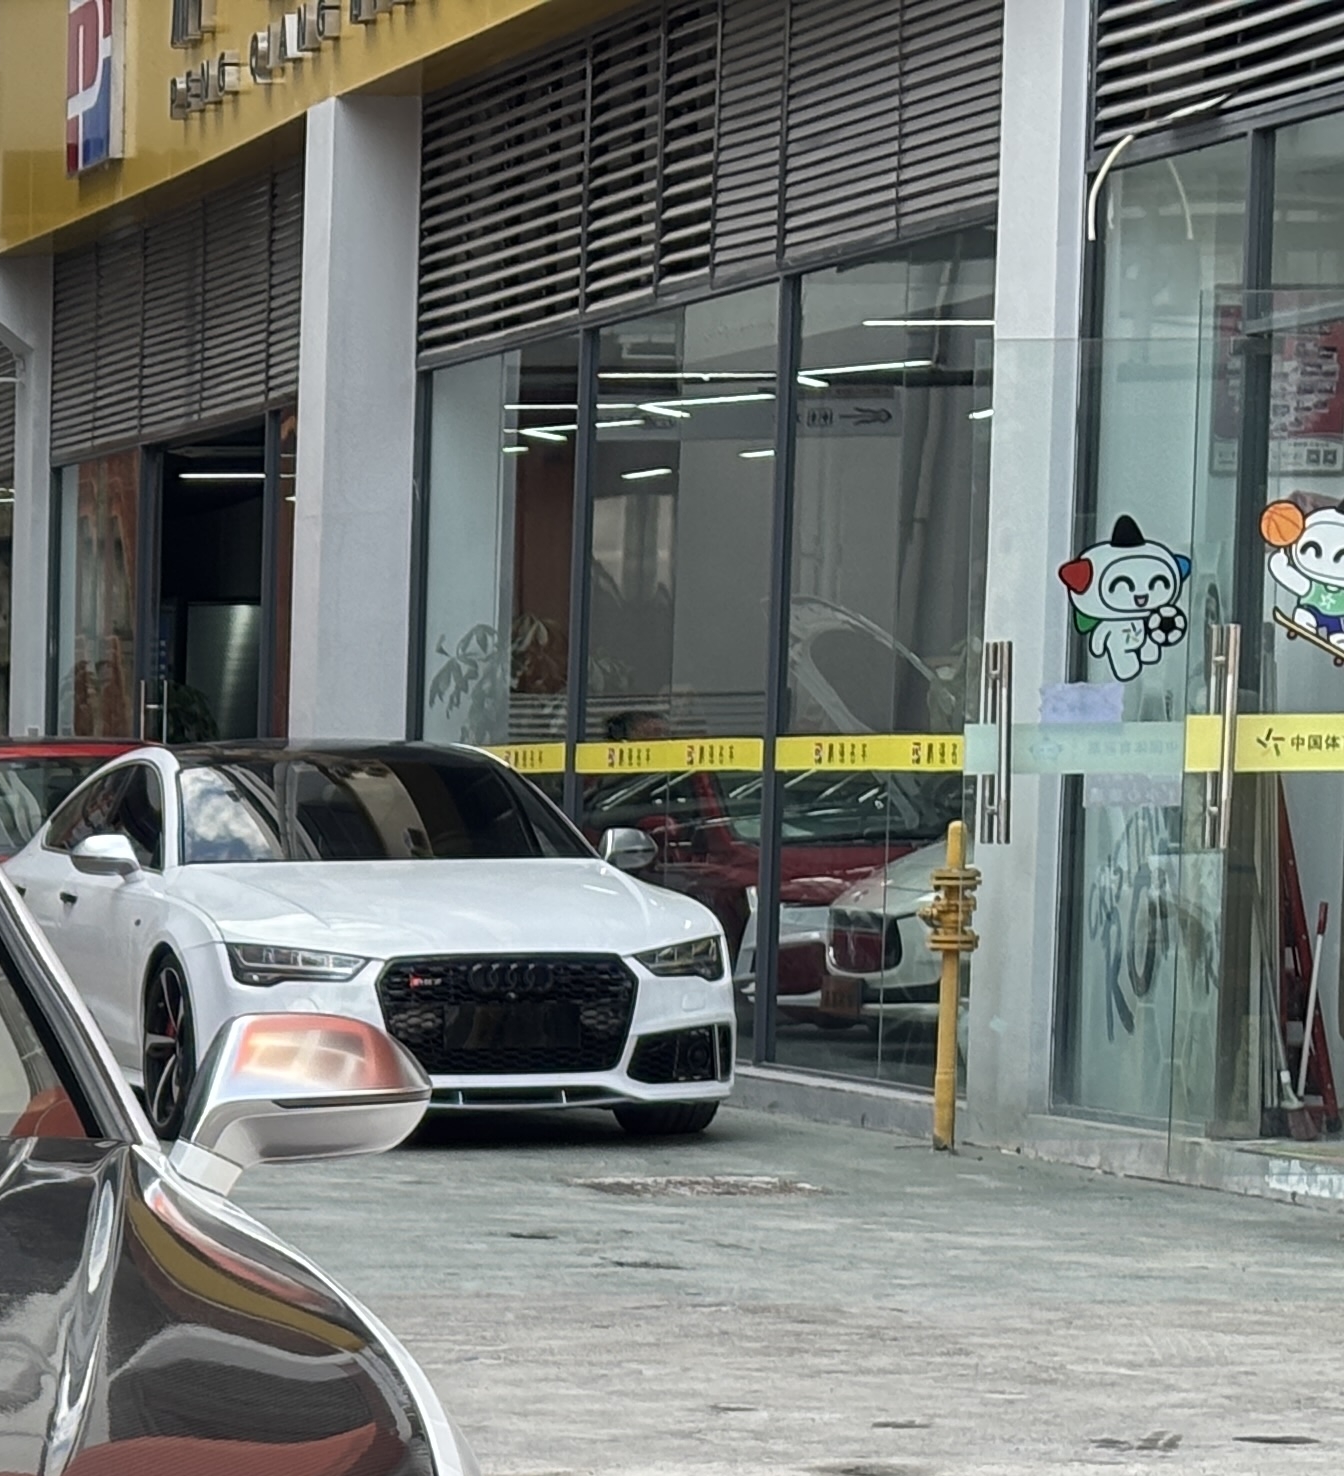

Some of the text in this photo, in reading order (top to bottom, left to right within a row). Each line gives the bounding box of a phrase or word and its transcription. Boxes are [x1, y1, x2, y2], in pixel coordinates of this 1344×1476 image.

[170, 51, 240, 120] PENG
[249, 0, 340, 83] QIANG
[1291, 733, 1344, 752] 中国体
